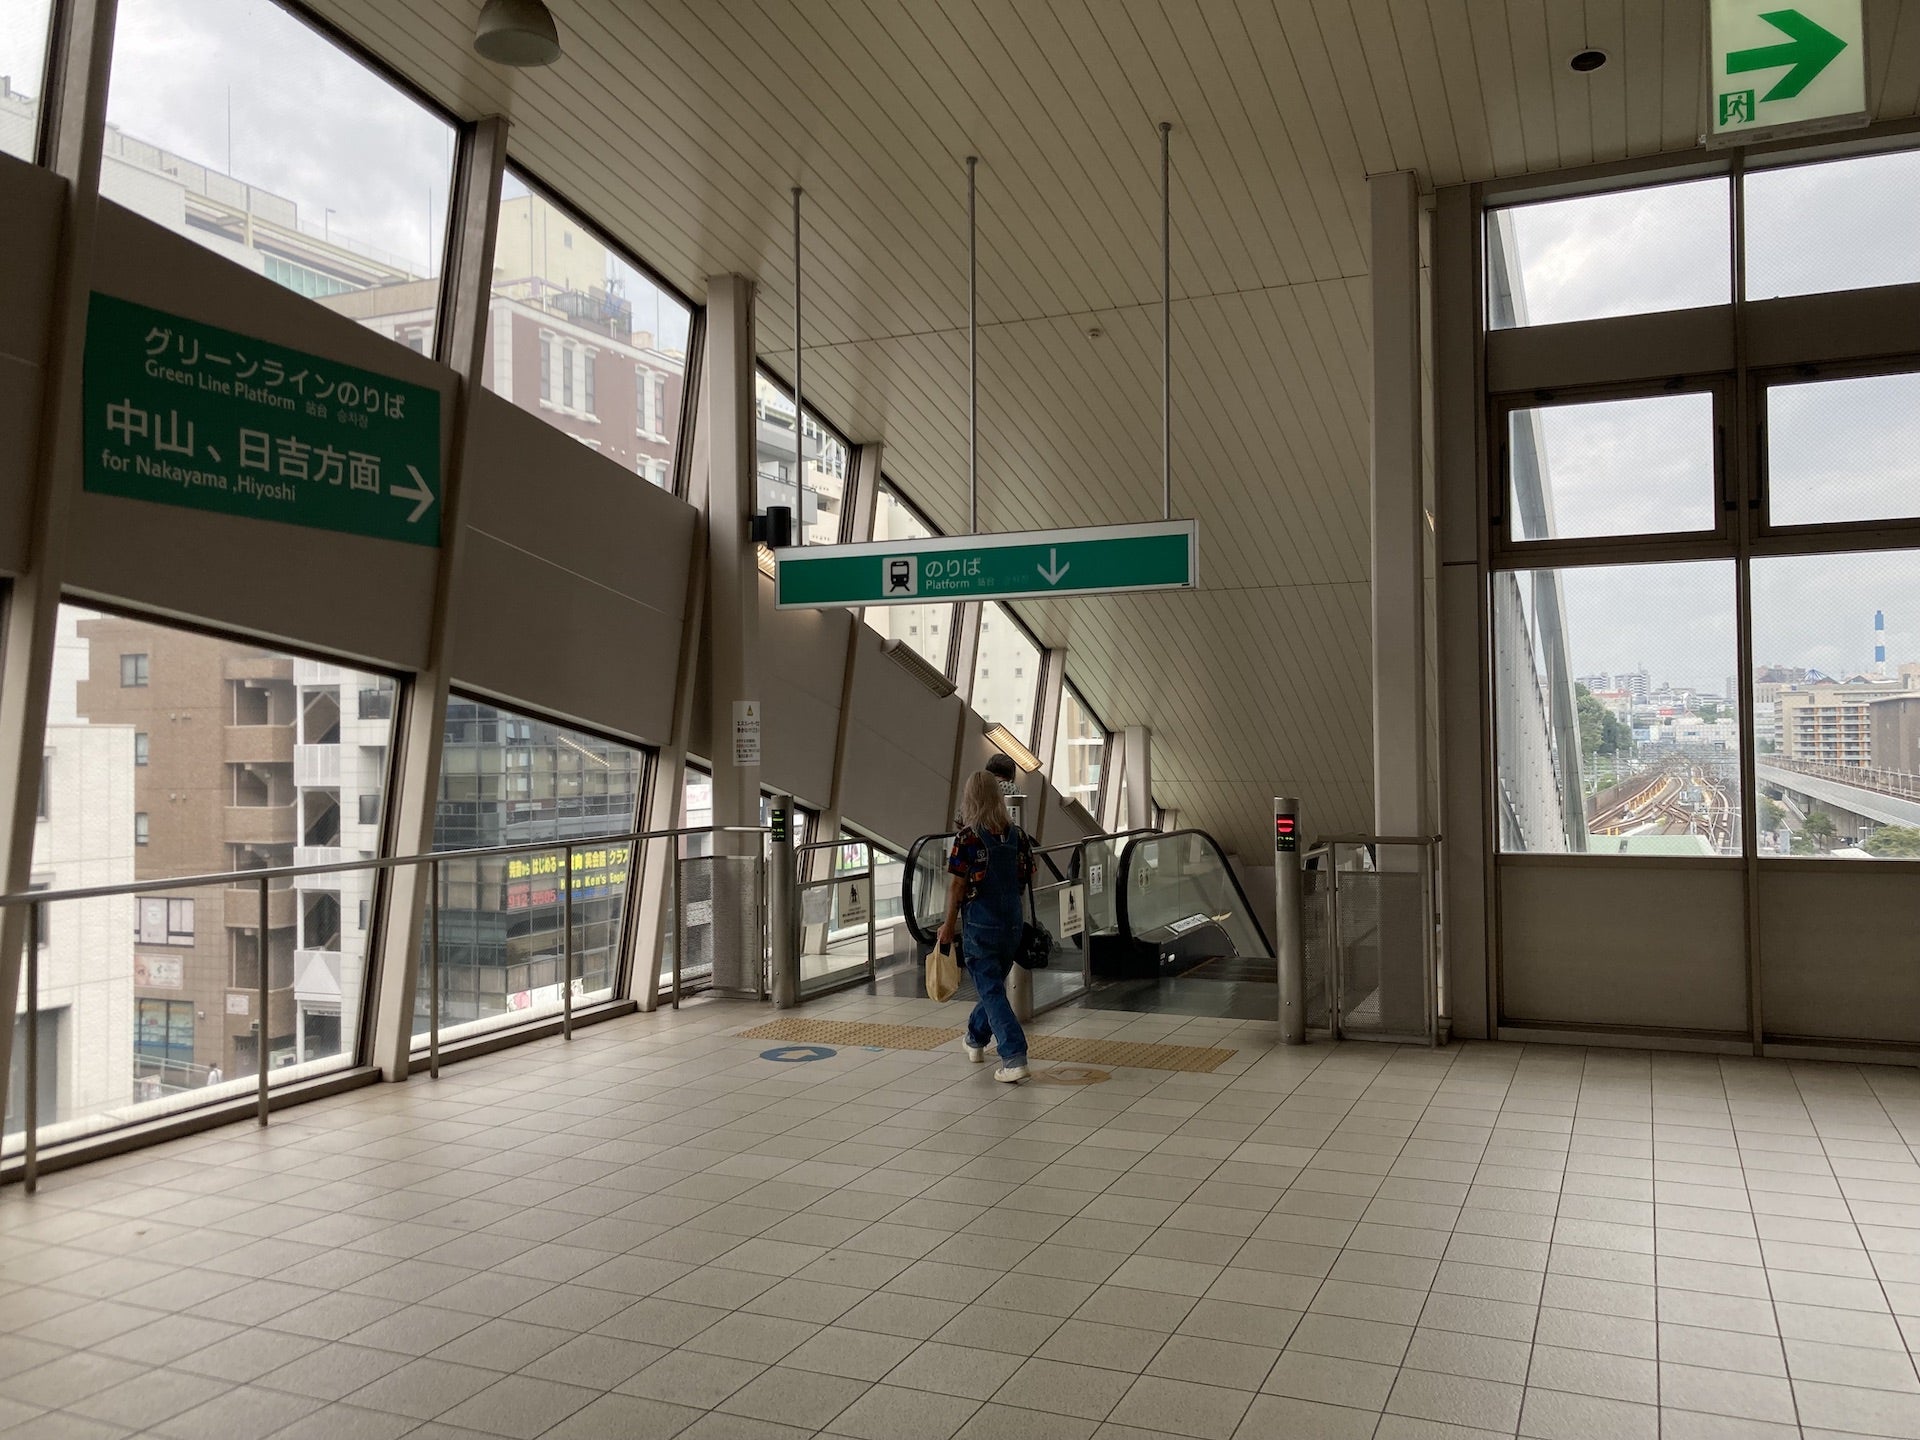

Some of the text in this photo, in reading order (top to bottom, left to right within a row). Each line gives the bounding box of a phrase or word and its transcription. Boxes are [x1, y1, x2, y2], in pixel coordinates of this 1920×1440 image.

[144, 327, 406, 419] グリーンラインのりば
[145, 359, 296, 411] Green Line Platform
[106, 398, 381, 495] 中山、日吉方面
[102, 449, 130, 472] for
[135, 454, 228, 488] Nakayama
[925, 557, 982, 578] のりば
[925, 578, 970, 590] Platform
[560, 878, 581, 890] Hra
[584, 874, 607, 887] Ken's
